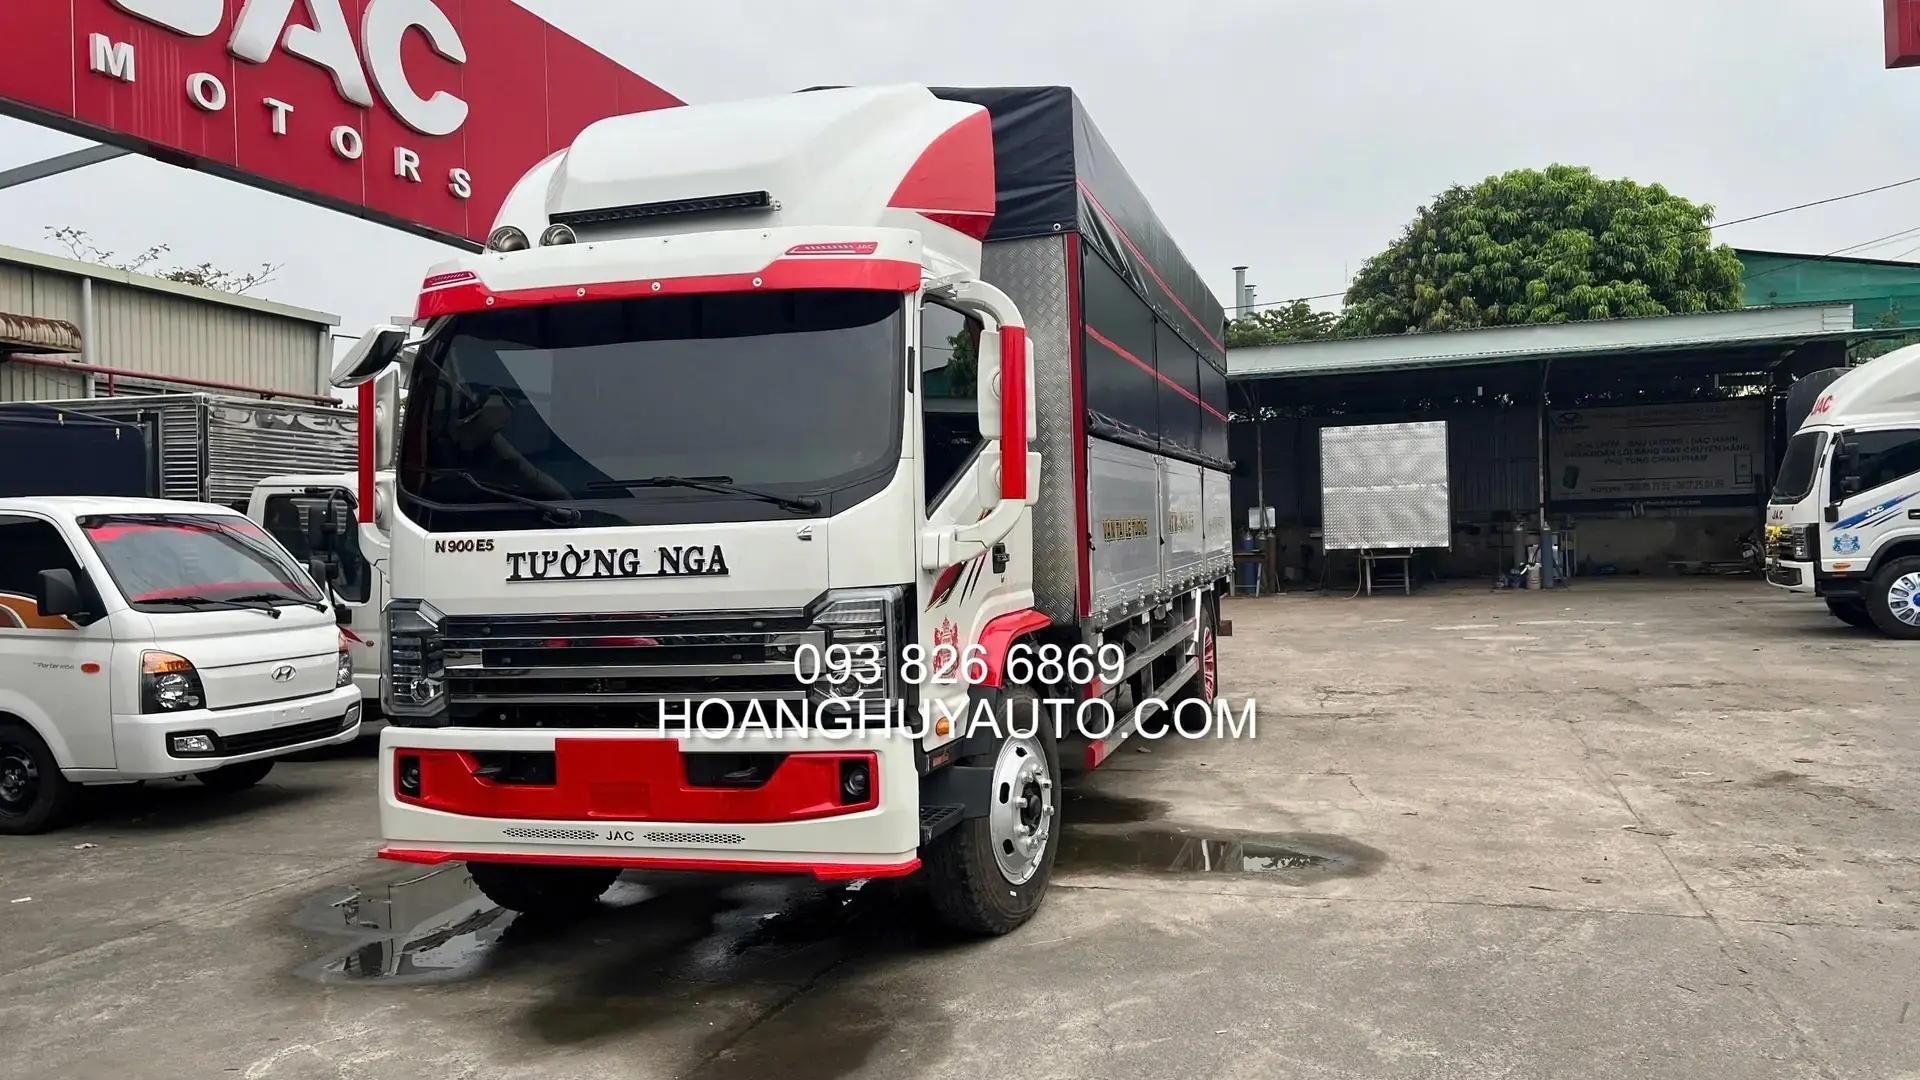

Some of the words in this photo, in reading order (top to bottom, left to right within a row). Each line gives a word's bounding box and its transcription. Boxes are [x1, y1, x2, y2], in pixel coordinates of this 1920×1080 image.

[107, 0, 469, 136] AC
[88, 32, 473, 199] MOTORS
[1811, 394, 1834, 415] JAC
[1771, 509, 1784, 520] JAC
[1864, 505, 1885, 518] JAC
[506, 544, 640, 580] TƯỜNG
[658, 544, 730, 575] NGA
[605, 830, 635, 841] JAC
